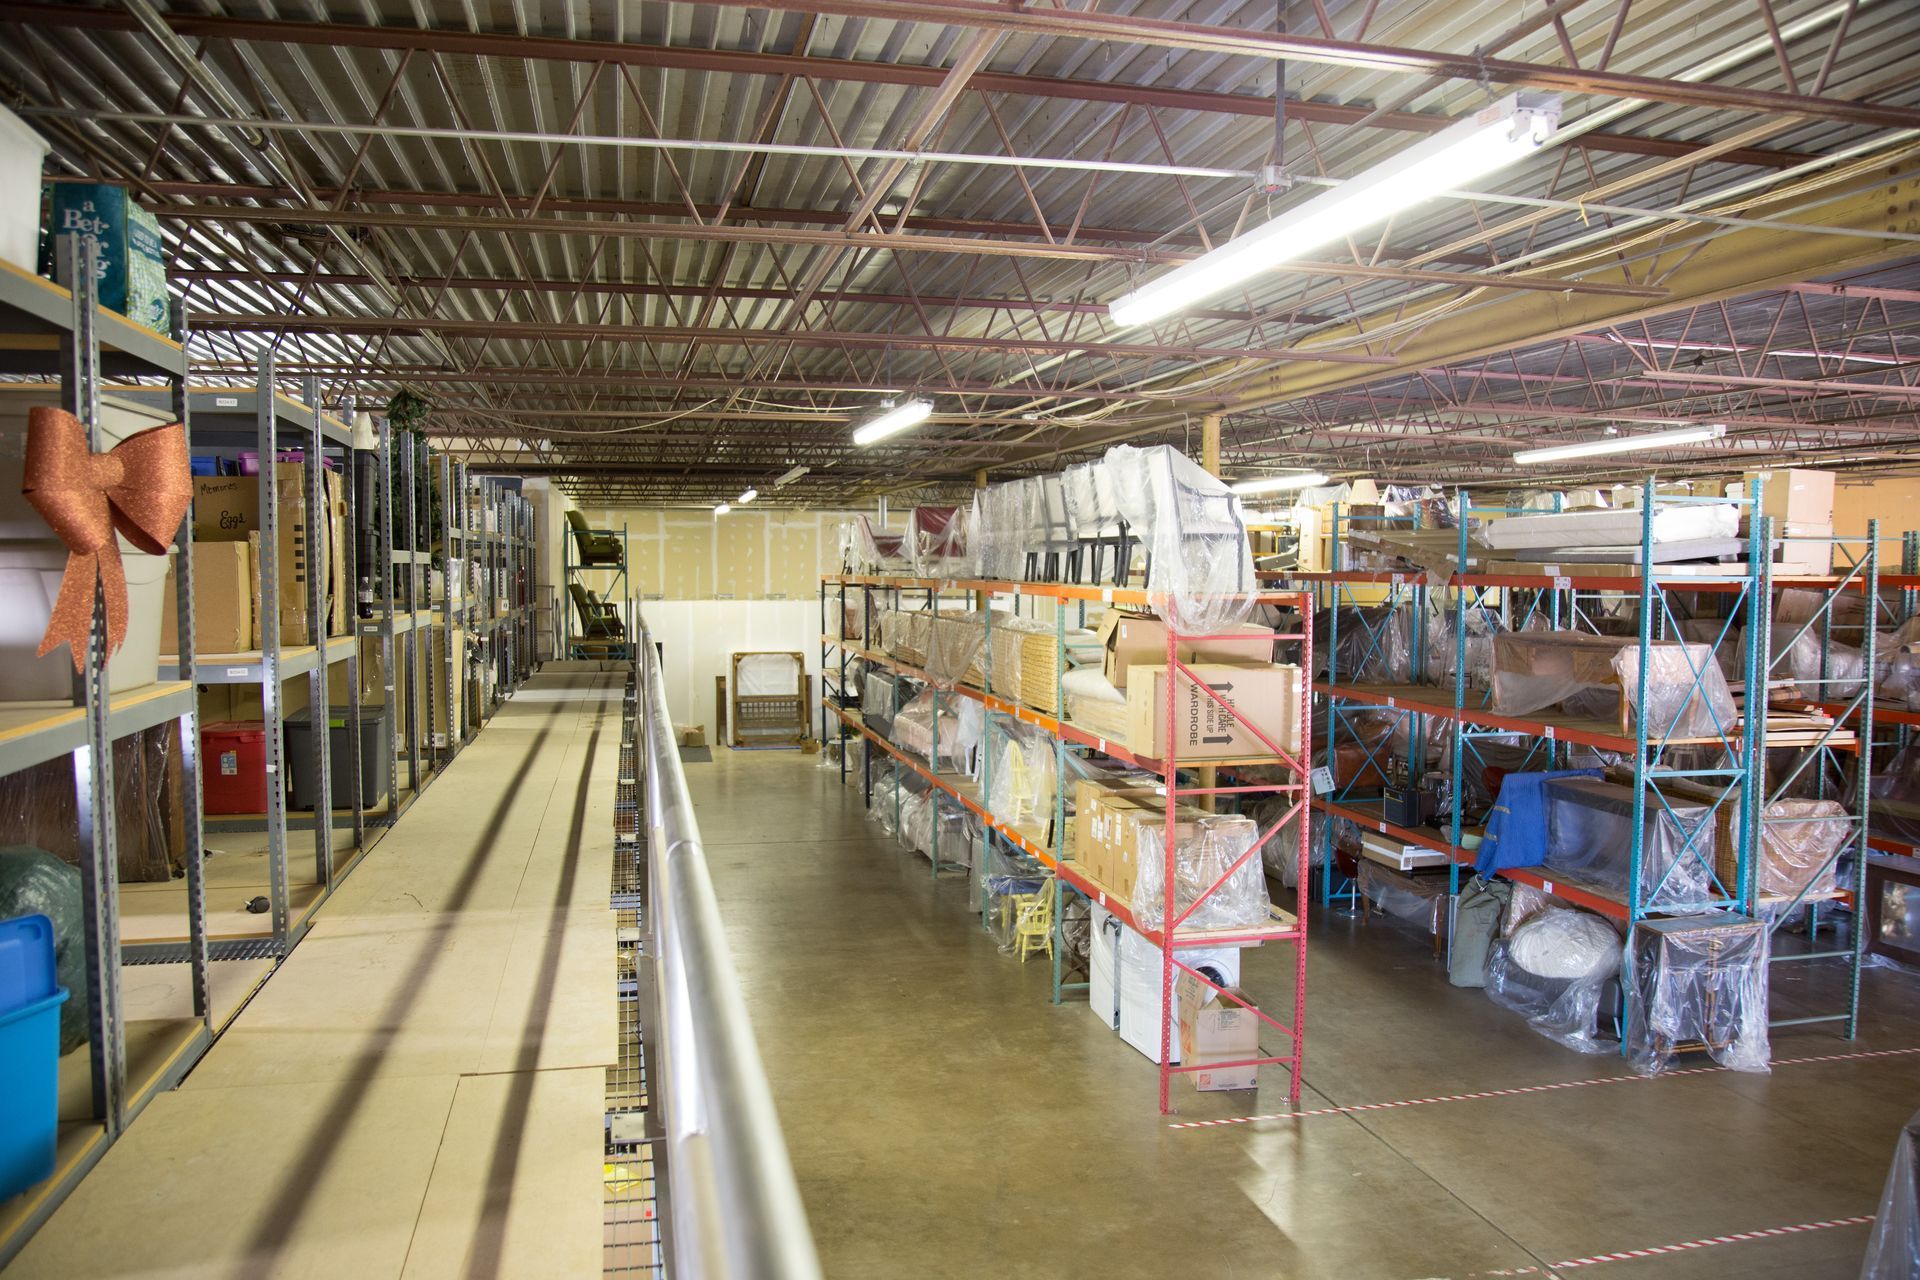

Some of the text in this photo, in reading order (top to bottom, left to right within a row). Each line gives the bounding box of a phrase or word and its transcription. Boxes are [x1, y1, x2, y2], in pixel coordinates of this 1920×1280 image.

[83, 200, 96, 212] a
[220, 510, 247, 529] Eggs
[1190, 683, 1199, 747] WARDROBE
[1227, 698, 1235, 728] HDLE
[1207, 724, 1214, 734] UP
[1218, 714, 1227, 733] CARE
